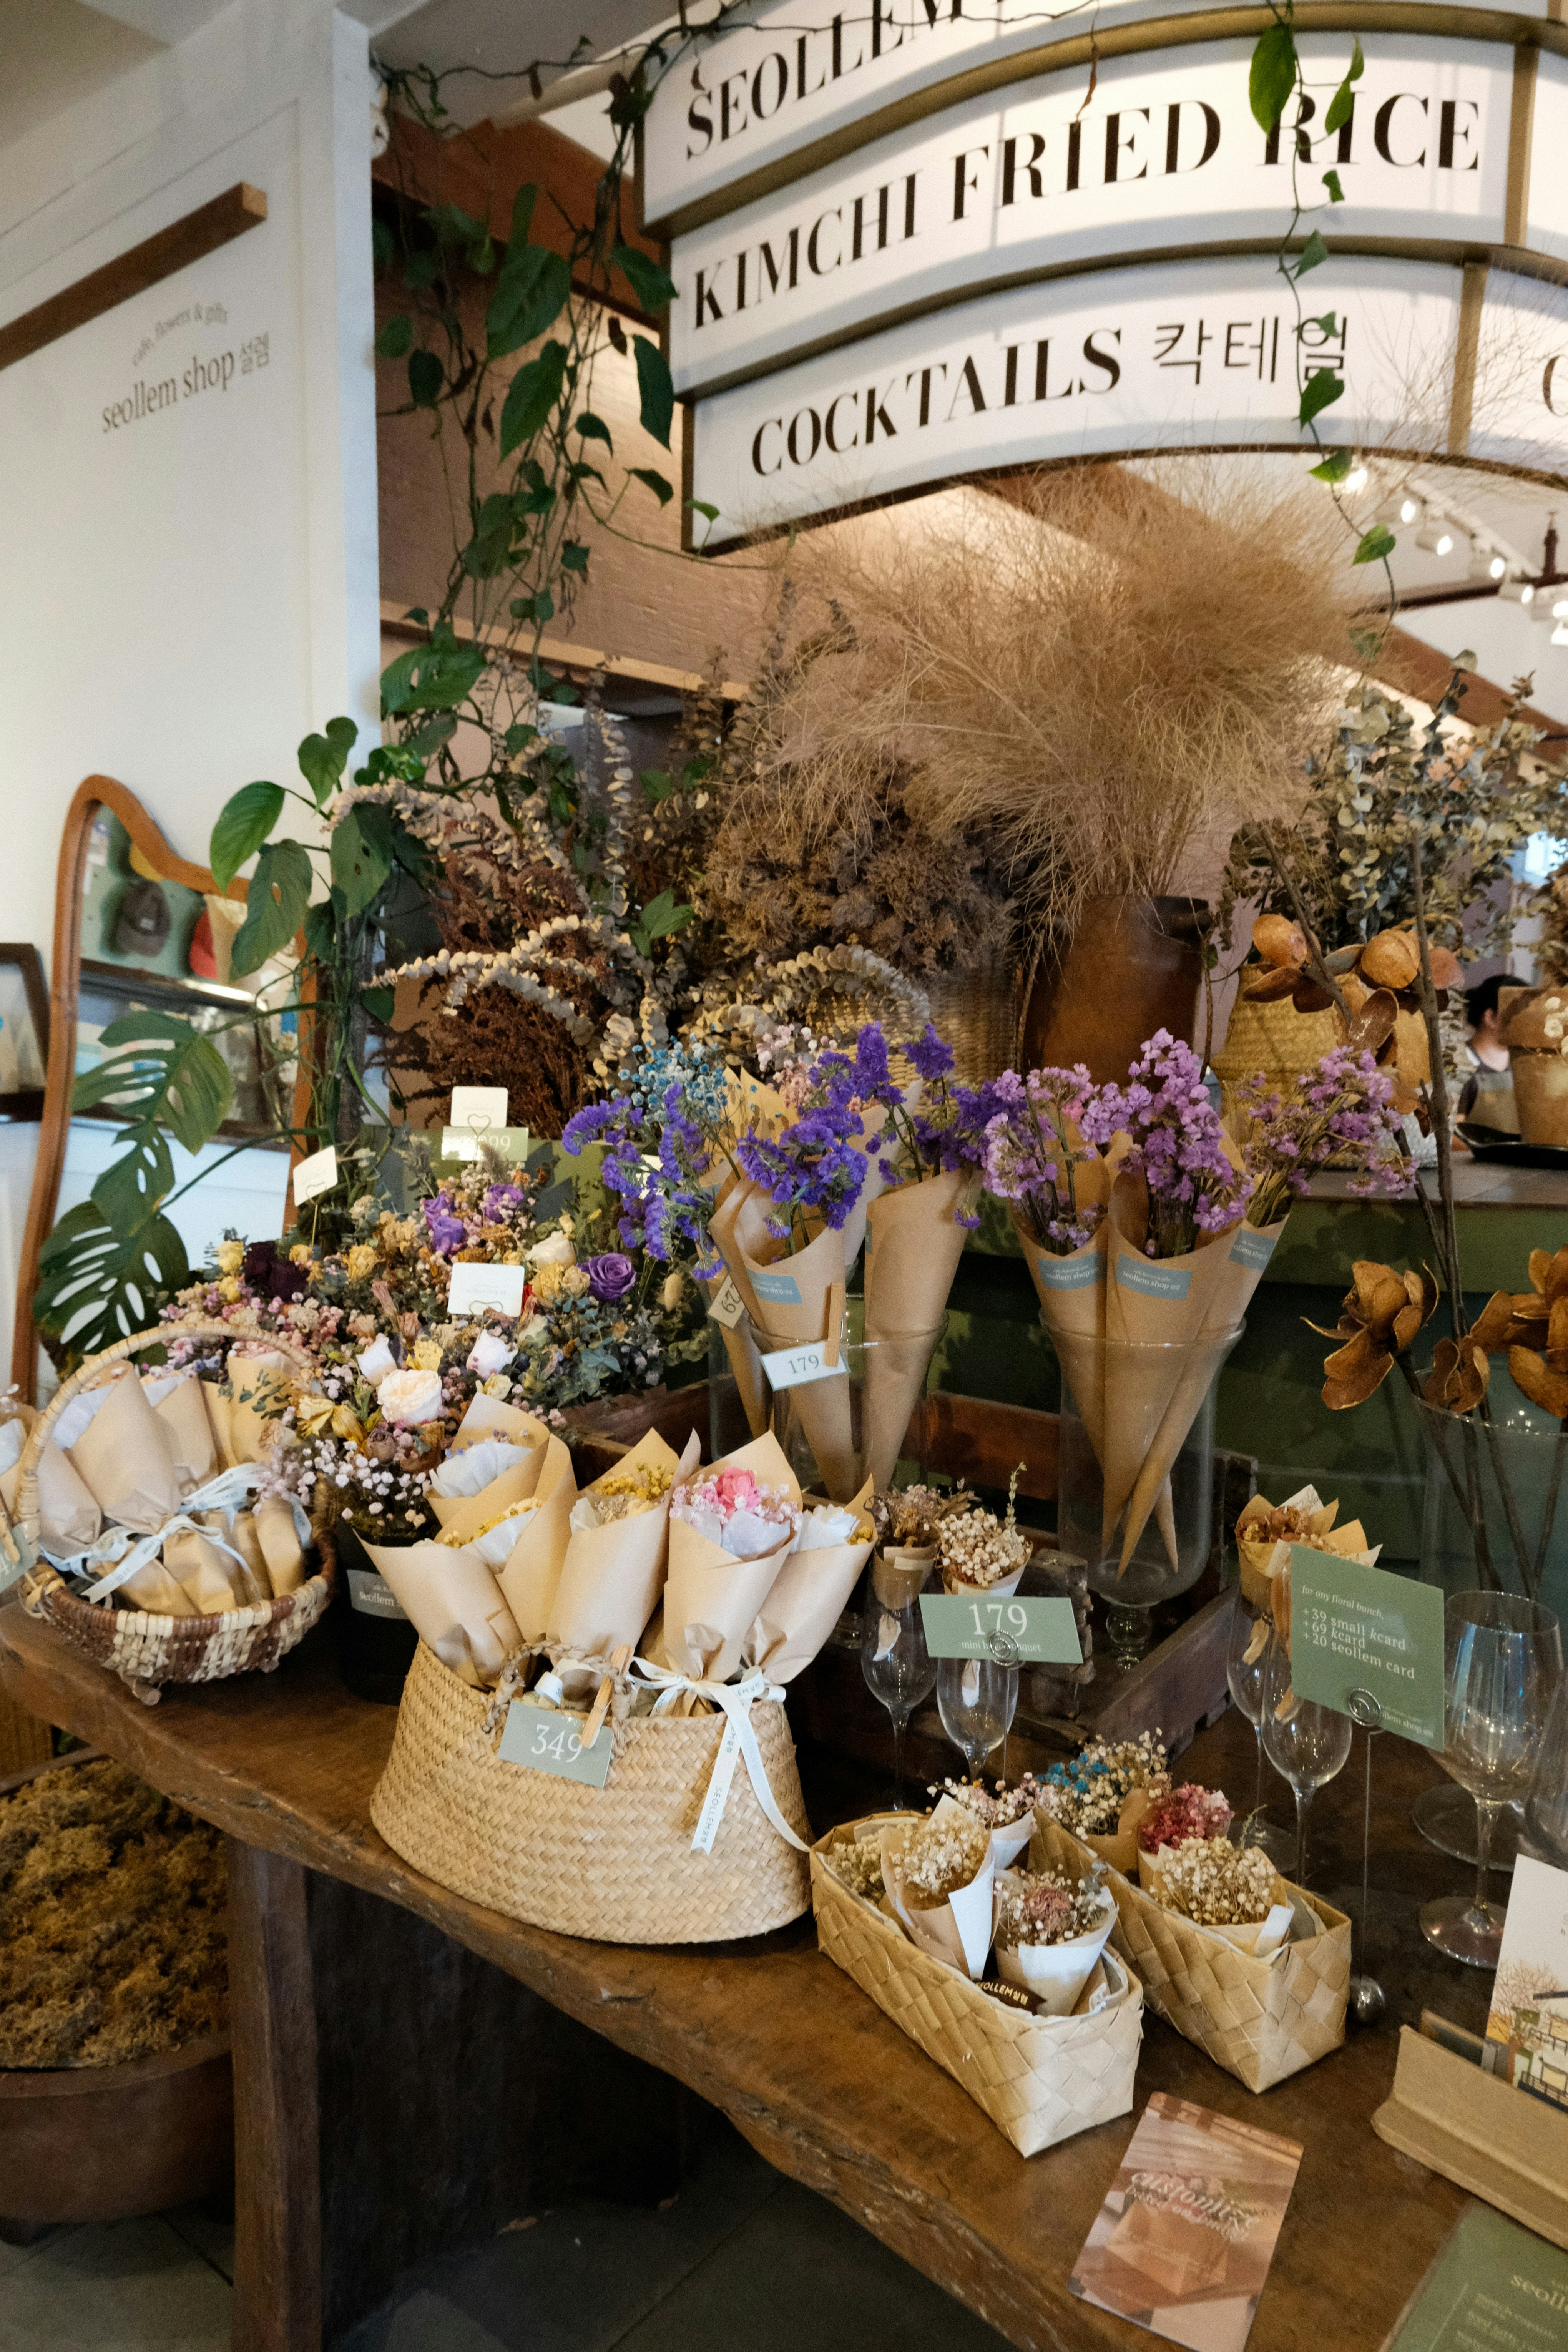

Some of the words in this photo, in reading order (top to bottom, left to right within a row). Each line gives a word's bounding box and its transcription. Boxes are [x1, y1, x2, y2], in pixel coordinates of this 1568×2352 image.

[694, 168, 924, 330] KIMCHI
[948, 99, 1221, 224] FRIED
[1255, 91, 1479, 171] RICE
[102, 377, 178, 433] seollem
[183, 351, 234, 398] shop
[751, 327, 1122, 477] COCKTAILS
[1153, 315, 1348, 385] 칵테일
[1073, 1271, 1090, 1279] shop
[1122, 1270, 1149, 1285] seollem
[1150, 1280, 1169, 1291] shop
[721, 1282, 741, 1313] 29
[788, 1354, 819, 1374] 179
[359, 1591, 394, 1606] seollem
[1301, 1585, 1314, 1595] for
[1316, 1591, 1330, 1602] any
[1332, 1594, 1355, 1609] floral
[1356, 1602, 1384, 1620] bunch,
[969, 1603, 1028, 1636] 179
[1312, 1608, 1327, 1623] 39
[1331, 1617, 1365, 1636] small
[1370, 1628, 1406, 1651] kcard
[1312, 1621, 1327, 1634] 69
[1331, 1627, 1365, 1649] kcard
[962, 1640, 980, 1649] mini
[1312, 1633, 1327, 1647] 20
[1331, 1642, 1382, 1668] seollem
[1386, 1661, 1415, 1680] card
[1403, 1720, 1422, 1734] shop
[530, 1724, 582, 1764] 349
[706, 1787, 722, 1829] SEOLLEM
